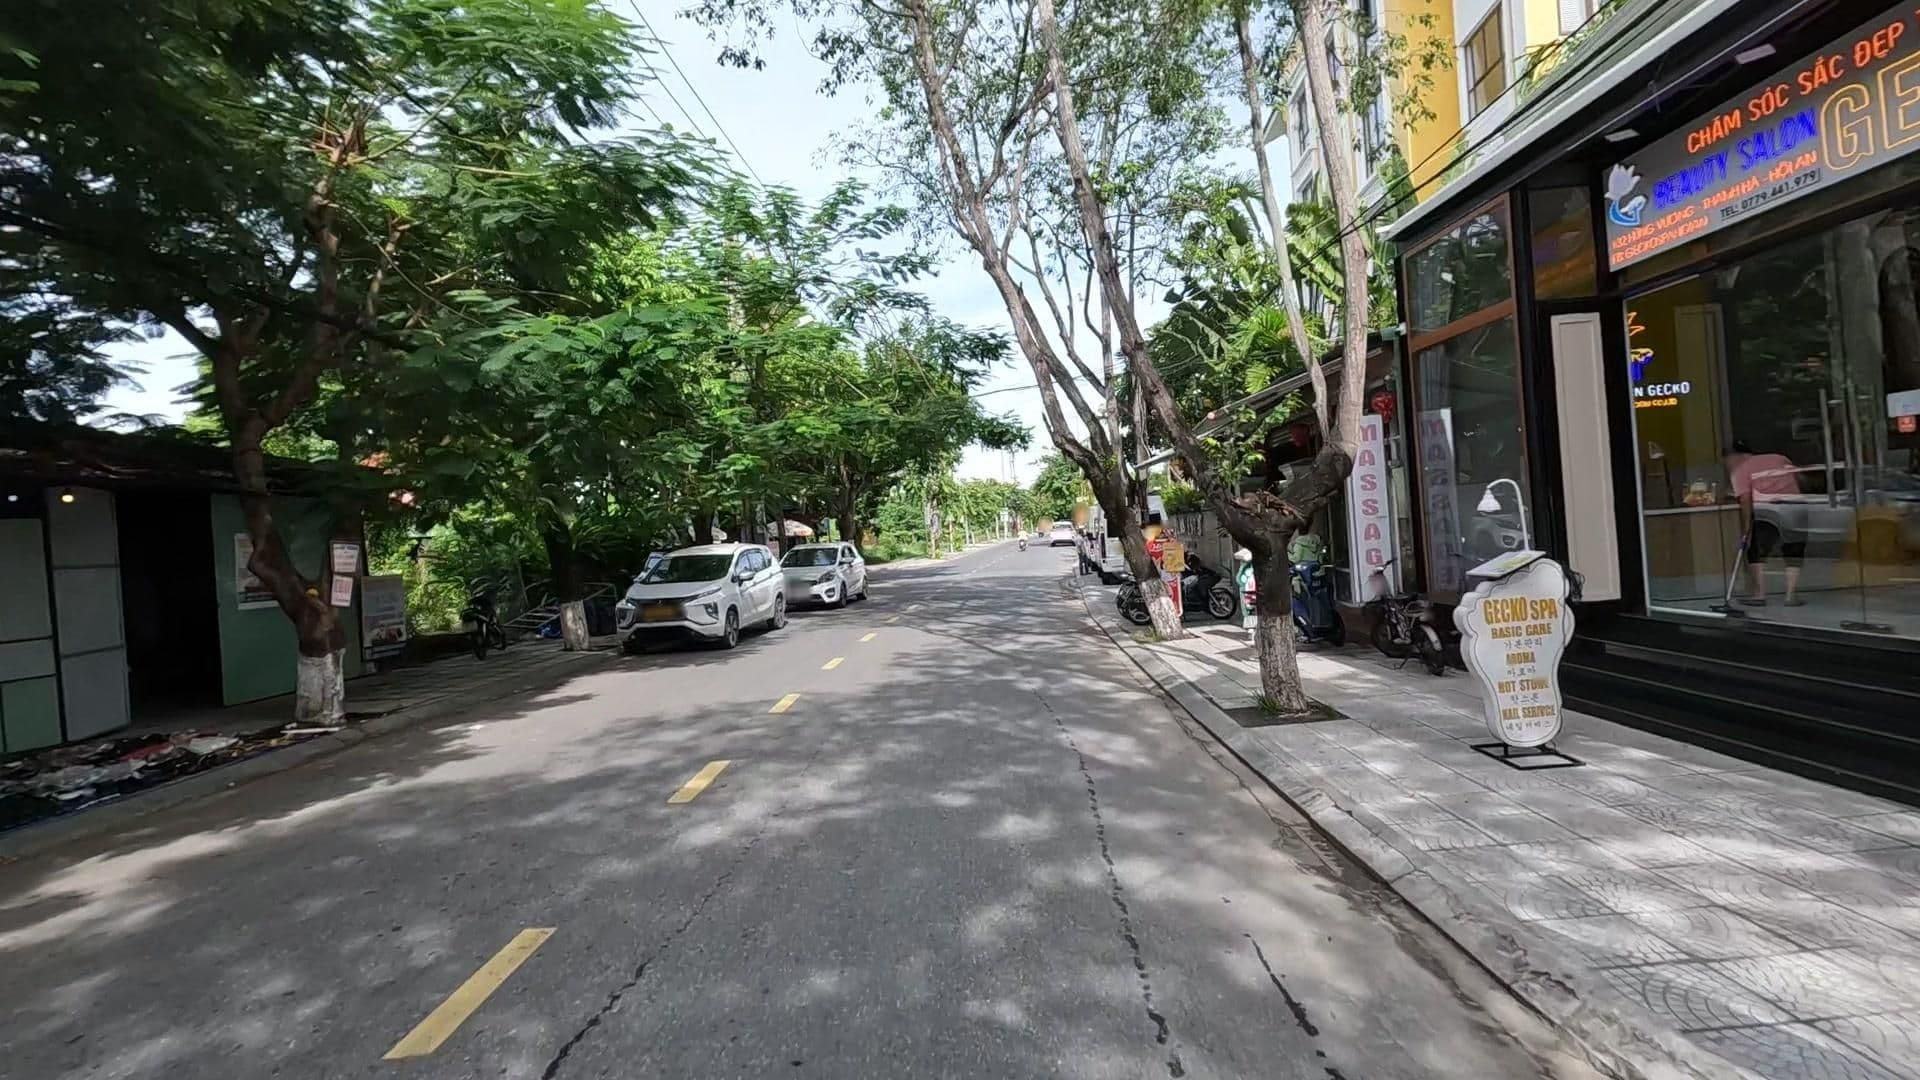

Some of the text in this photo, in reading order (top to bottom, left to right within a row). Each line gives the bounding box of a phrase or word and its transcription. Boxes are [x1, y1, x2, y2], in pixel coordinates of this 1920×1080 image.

[1747, 83, 1790, 121] SÓC
[1853, 21, 1905, 68] ĐẸP
[1652, 106, 1818, 209] BEAUTY SALON
[1794, 150, 1818, 170] AN
[1720, 204, 1739, 218] TEL:
[1647, 381, 1690, 396] GECKO
[1358, 423, 1384, 567] MASSAG
[1483, 596, 1558, 624] GECKO SPA
[1491, 622, 1553, 639] BASIC CARE
[1506, 651, 1536, 665] AROMA
[1497, 680, 1516, 694] HOT
[1502, 707, 1521, 720] NAIL
